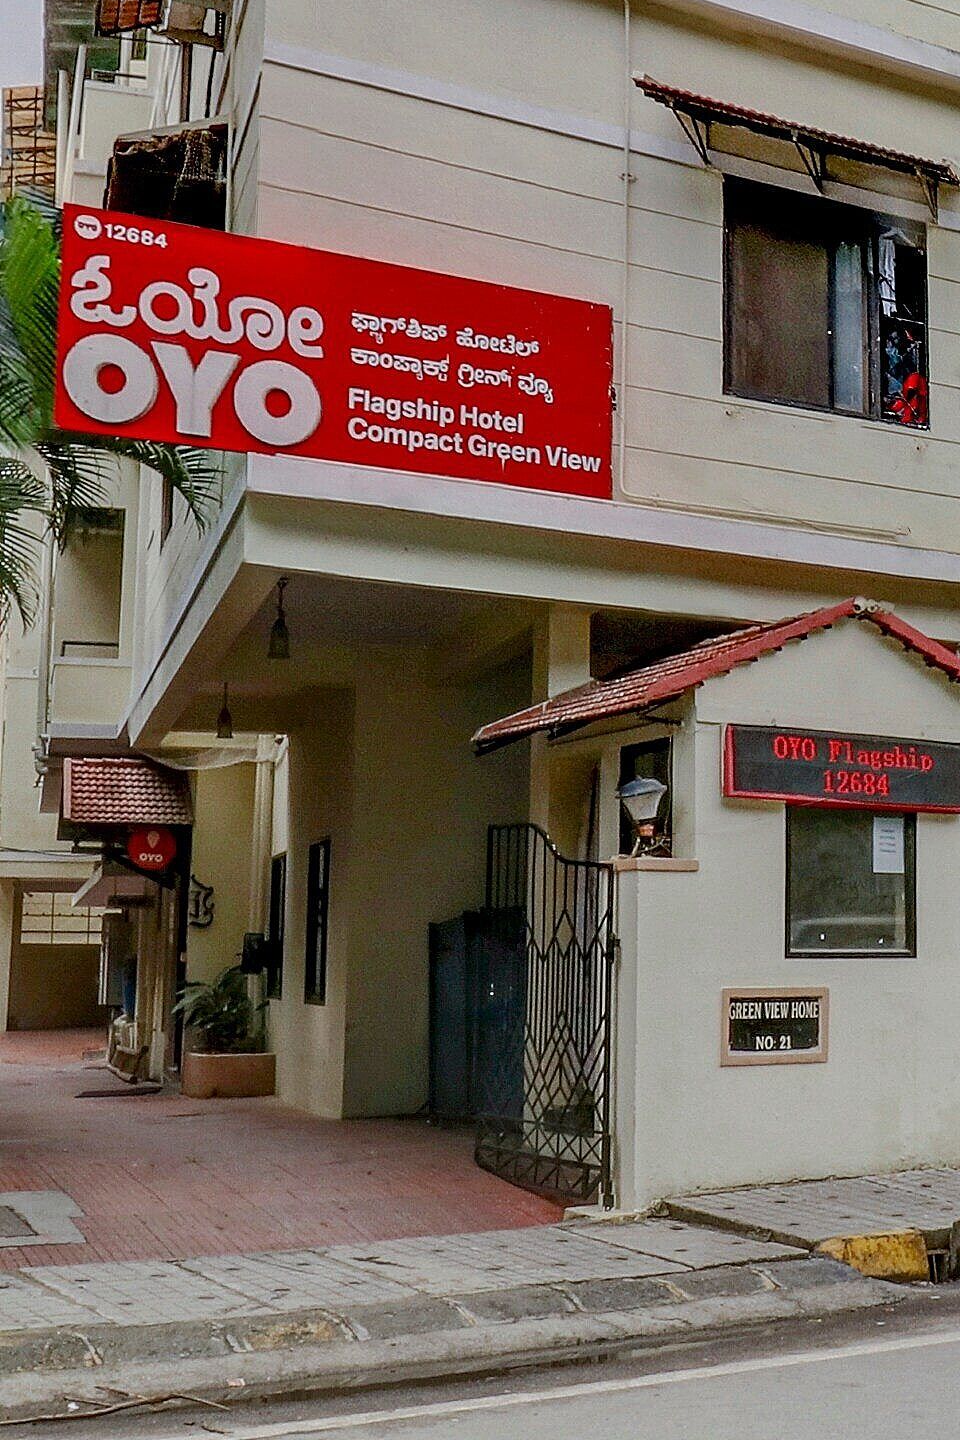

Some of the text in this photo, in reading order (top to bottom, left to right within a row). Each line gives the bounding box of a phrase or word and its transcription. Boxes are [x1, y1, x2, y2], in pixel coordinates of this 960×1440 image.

[104, 223, 168, 248] 12684
[70, 255, 324, 358] ಓಯೋ
[456, 327, 540, 357] ಹೋಟೆಲ್
[457, 362, 509, 388] ಗ್ರೀನ್
[63, 333, 322, 446] OYO
[348, 387, 524, 434] Flagship Hotel
[348, 417, 601, 473] Compact Green View
[773, 735, 935, 772] OYO Flagship
[823, 770, 890, 796] 12684
[139, 852, 163, 863] OYO
[729, 1001, 819, 1020] GREEN VIEW HOME
[755, 1035, 792, 1050] NO: 21
